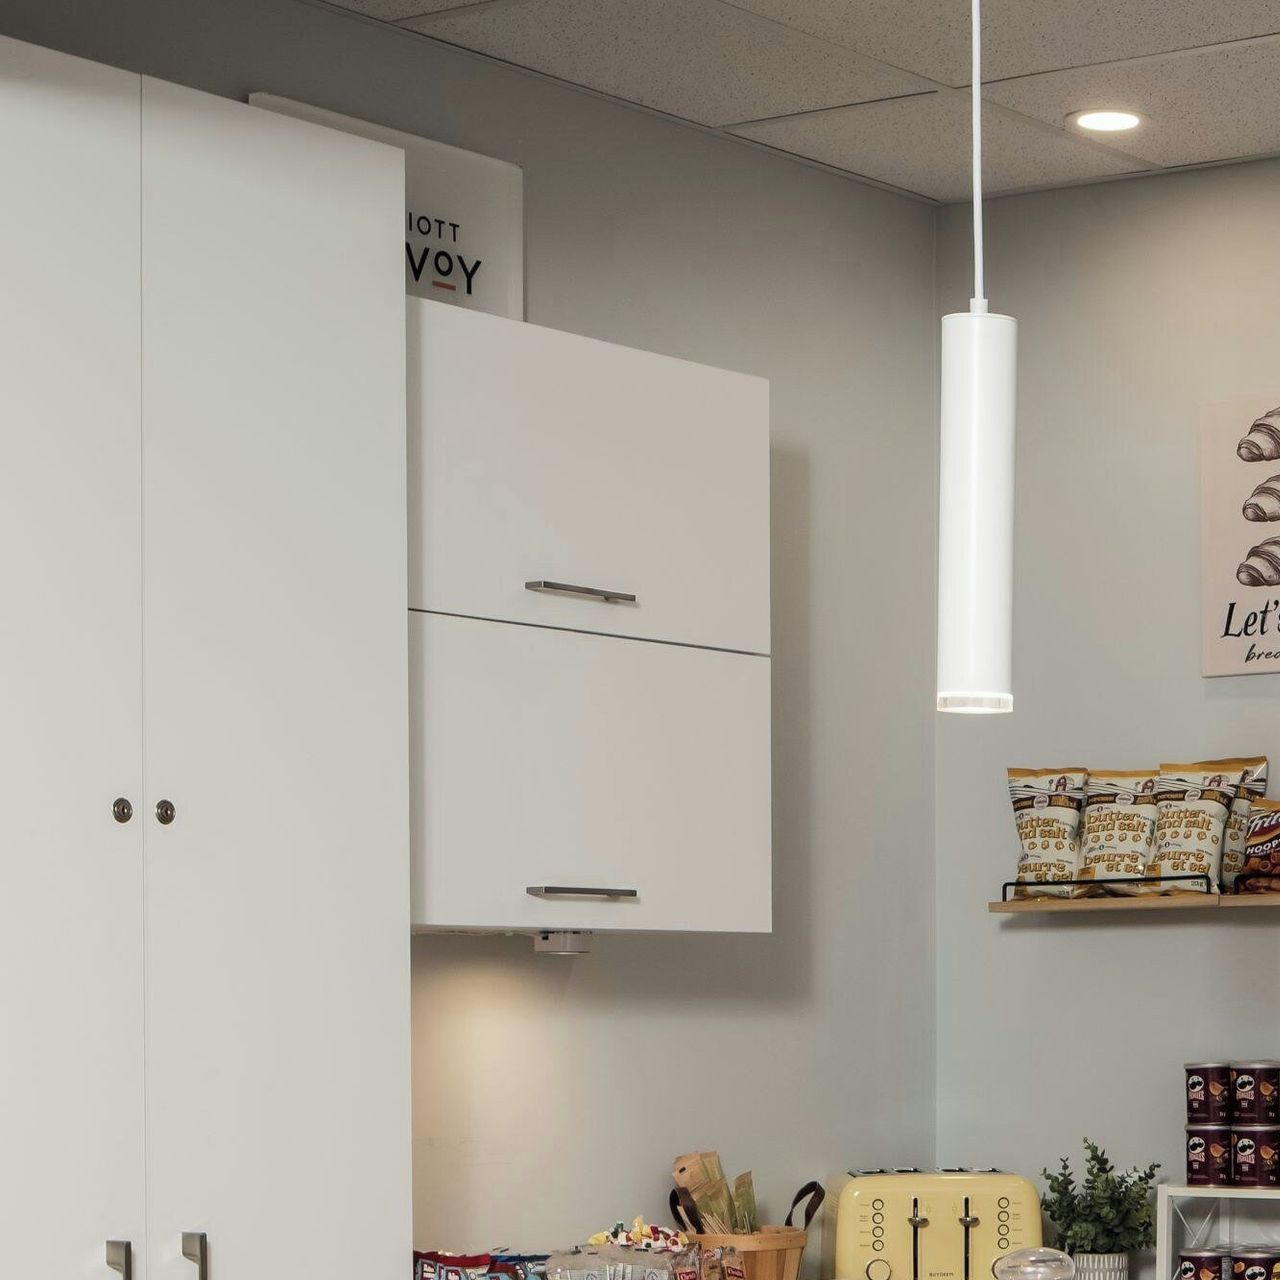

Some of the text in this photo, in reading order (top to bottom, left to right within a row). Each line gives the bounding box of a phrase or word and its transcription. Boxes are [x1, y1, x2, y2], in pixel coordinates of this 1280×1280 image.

[1086, 811, 1139, 825] butter
[1185, 817, 1213, 831] salt
[1087, 820, 1147, 834] and salt
[1084, 853, 1139, 866] beurre
[1018, 862, 1066, 874] eurre
[1105, 862, 1120, 873] et
[1171, 860, 1211, 875] et sel
